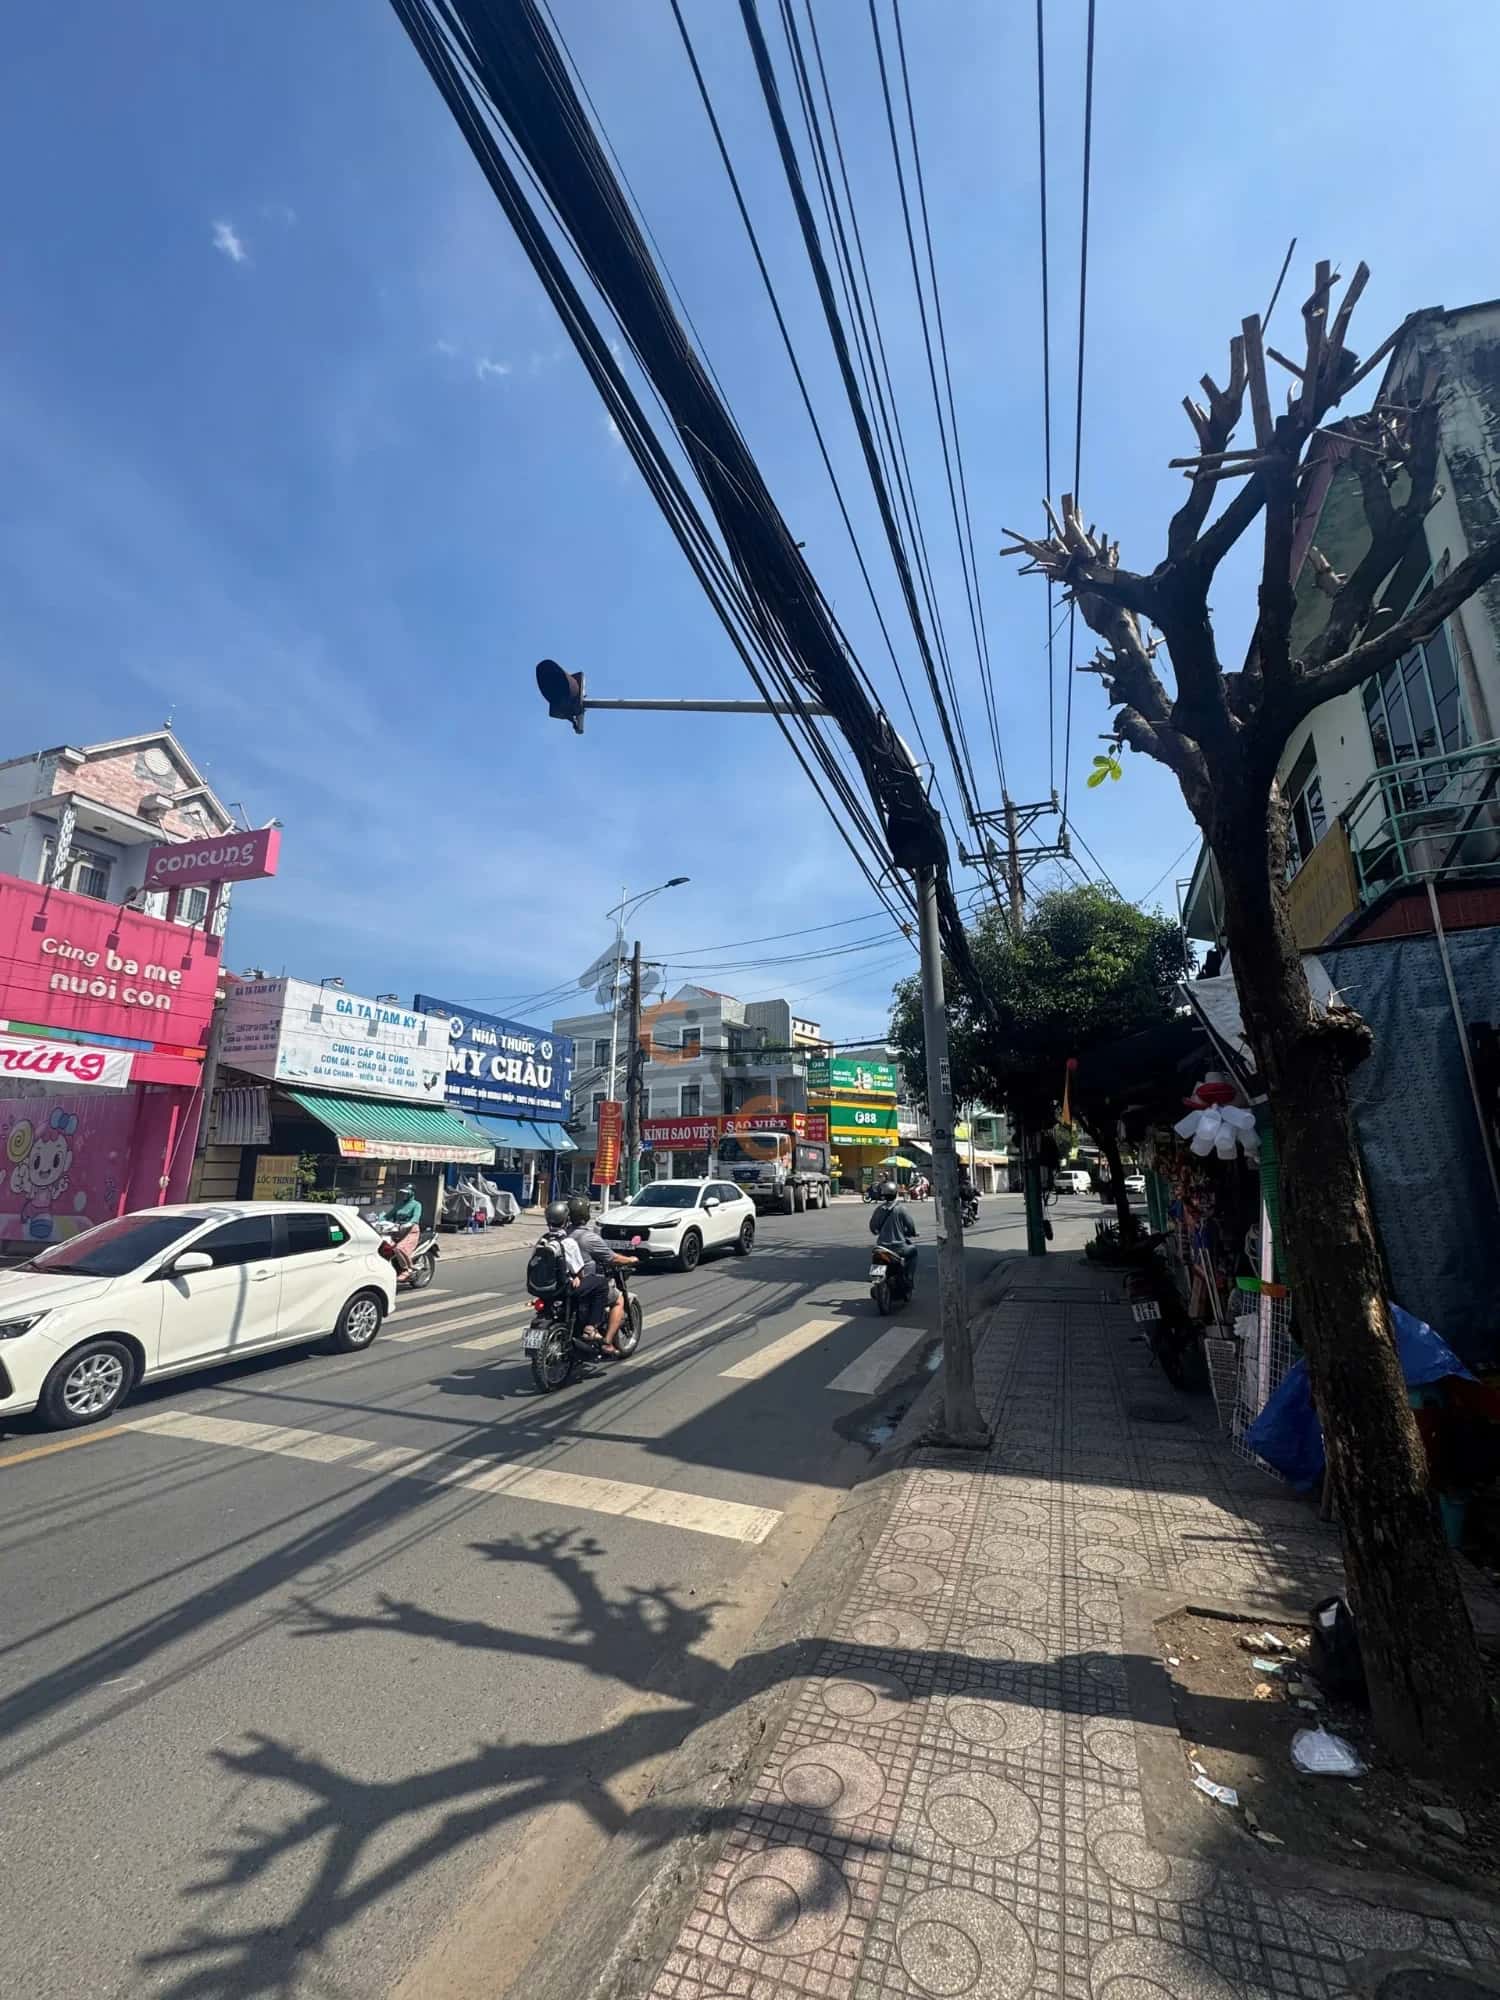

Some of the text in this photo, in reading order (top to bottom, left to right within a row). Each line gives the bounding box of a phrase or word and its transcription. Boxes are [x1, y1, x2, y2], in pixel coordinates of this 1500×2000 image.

[42, 938, 182, 990] Cùng ba mẹ
[50, 973, 171, 1010] nuôi con
[471, 1028, 536, 1055] NHÀ THUỐC
[491, 1056, 553, 1089] CHÂU
[644, 1124, 669, 1141] KÍNH
[671, 1127, 691, 1140] SAO
